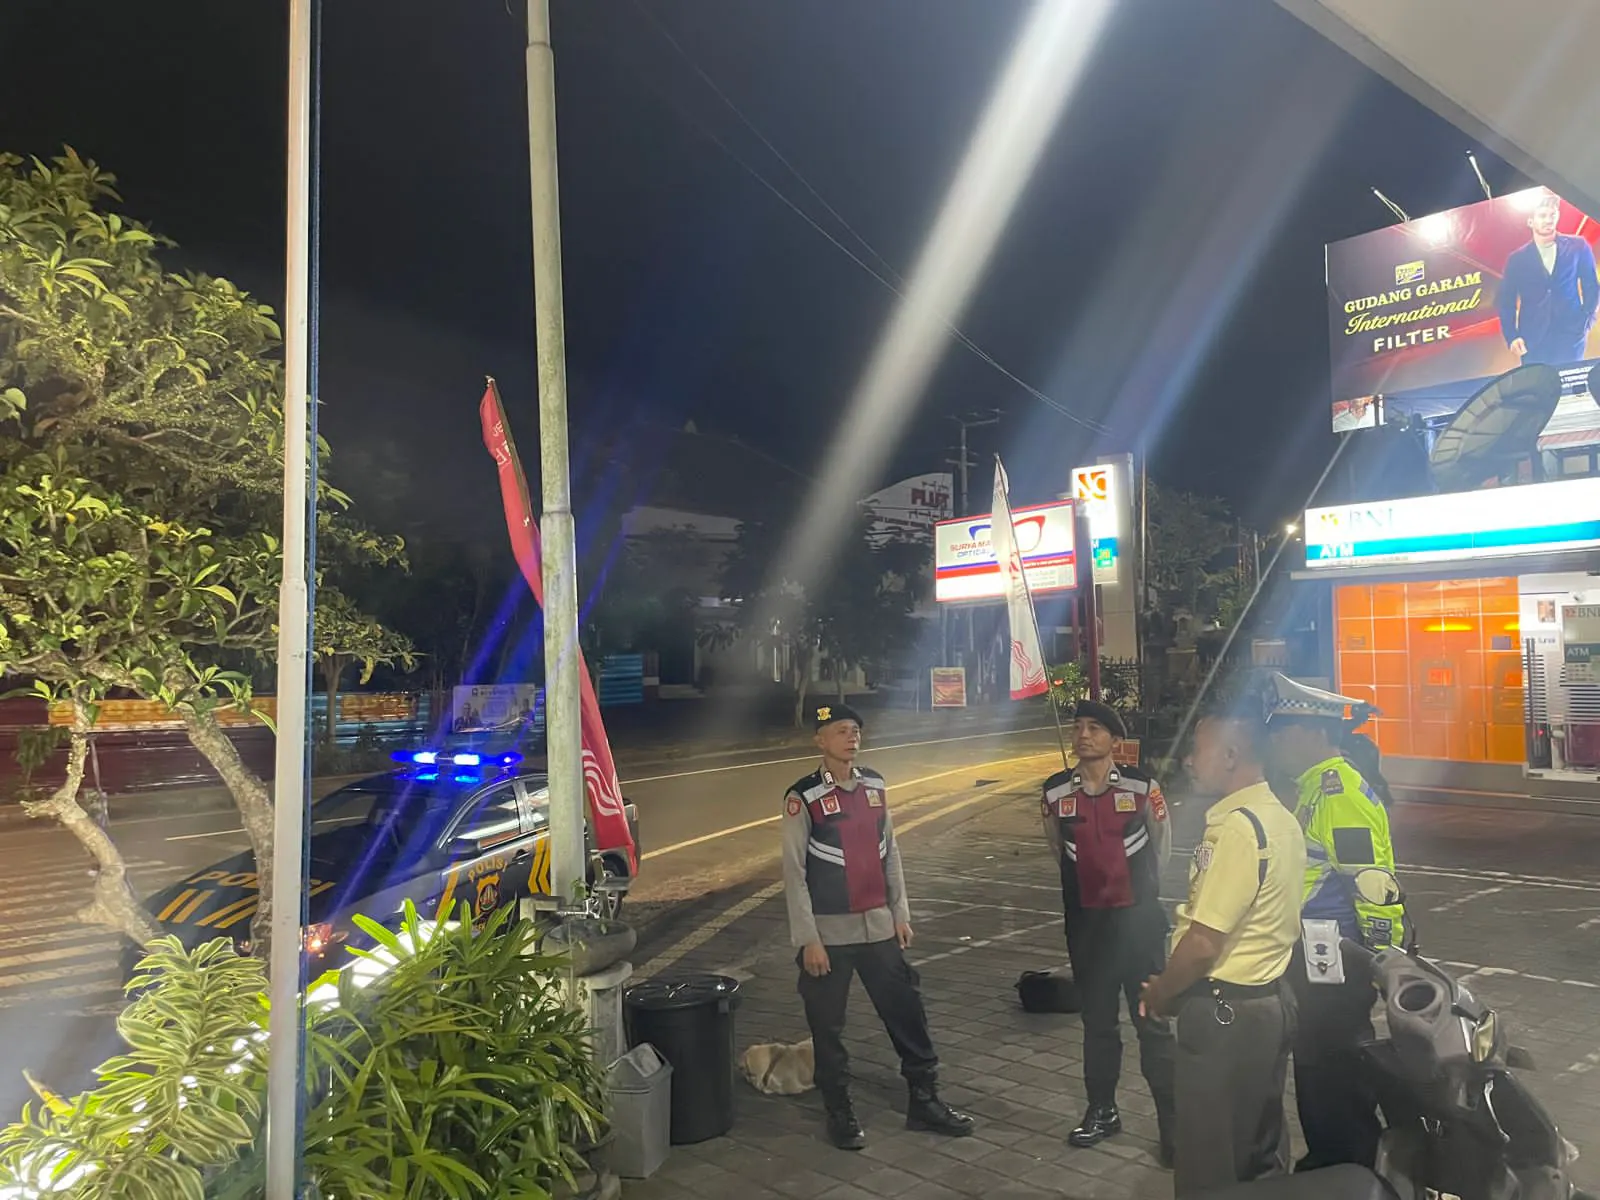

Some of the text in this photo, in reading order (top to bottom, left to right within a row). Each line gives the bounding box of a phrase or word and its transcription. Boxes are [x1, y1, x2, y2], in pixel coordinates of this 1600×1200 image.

[1344, 288, 1412, 313] GUDANG
[1416, 272, 1482, 297] GARAM
[1344, 288, 1483, 335] International
[1374, 325, 1452, 353] FILTER
[1320, 541, 1355, 559] ATM
[1567, 647, 1590, 657] ATM
[468, 855, 508, 883] POLISI
